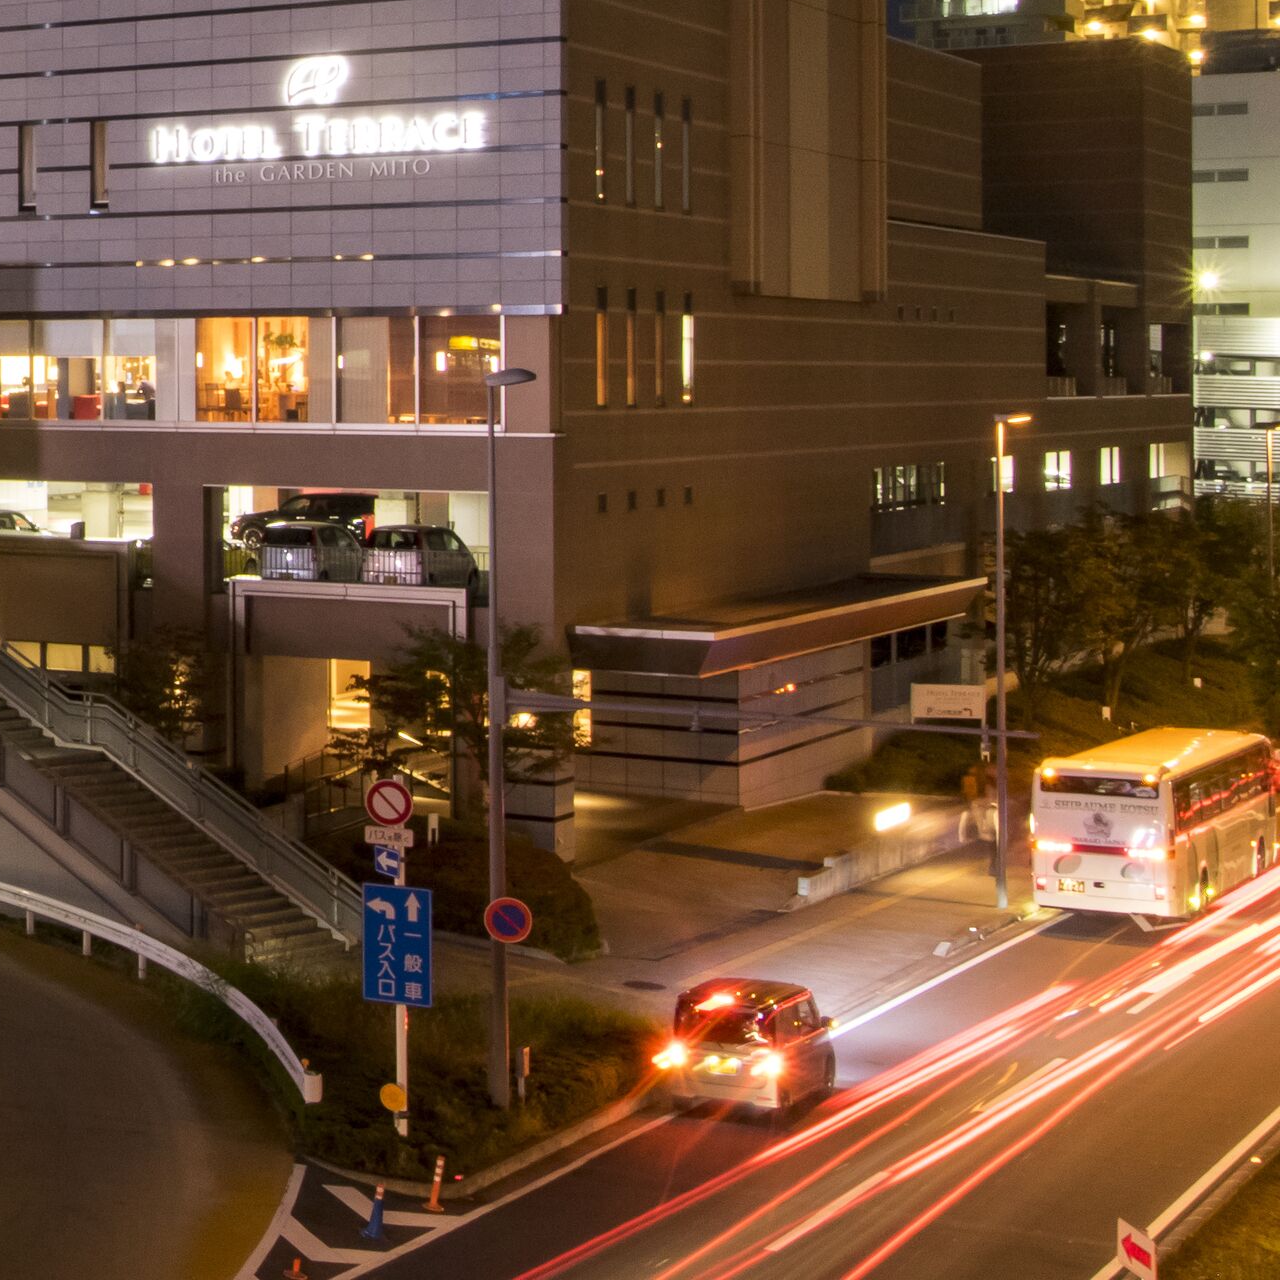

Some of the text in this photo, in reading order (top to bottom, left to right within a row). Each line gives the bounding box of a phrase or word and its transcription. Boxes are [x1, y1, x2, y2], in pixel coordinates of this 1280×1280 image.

[149, 113, 490, 163] HOTEL TERRACE
[215, 157, 430, 183] the GARDEN MITO
[376, 924, 396, 997] バス入口
[403, 932, 423, 1000] 一般車
